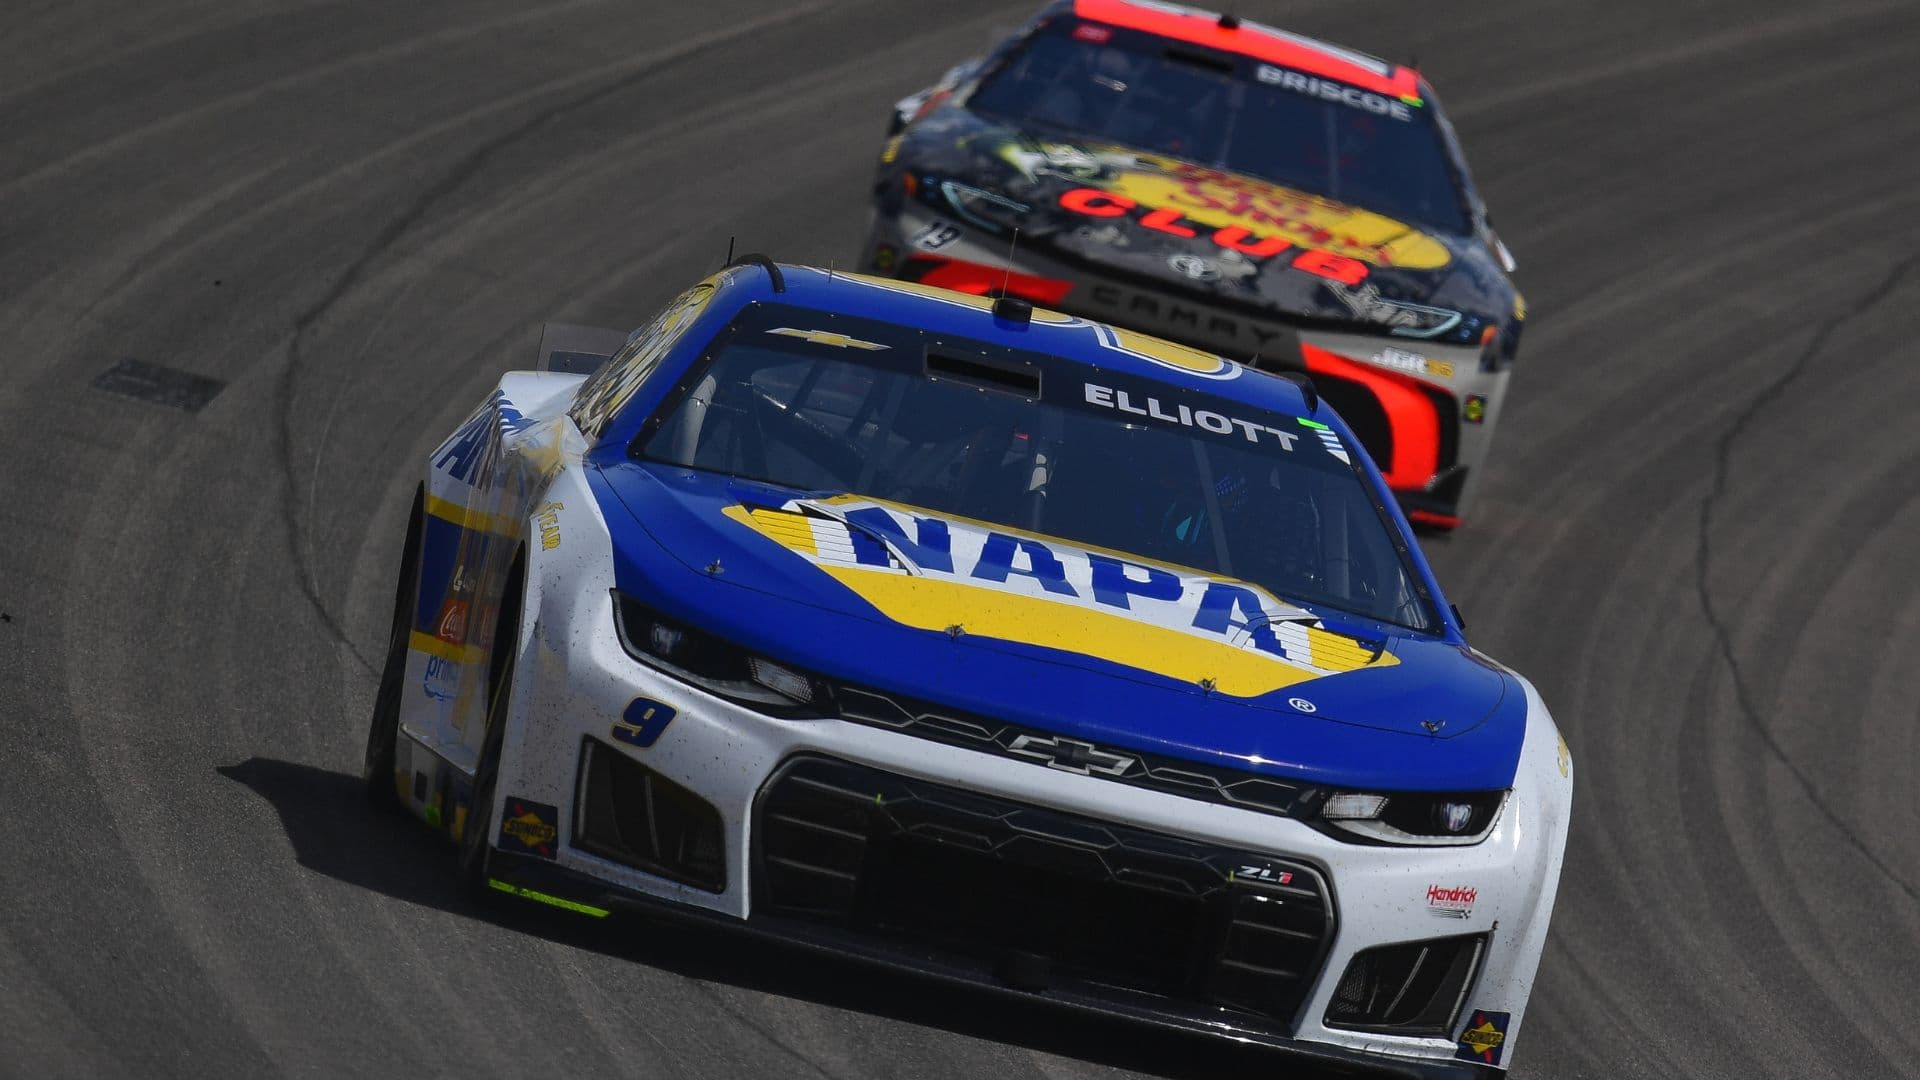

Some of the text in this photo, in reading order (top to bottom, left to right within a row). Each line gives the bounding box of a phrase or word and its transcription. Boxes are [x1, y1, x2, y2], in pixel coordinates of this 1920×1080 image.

[1257, 63, 1413, 122] BRISCOE
[1060, 188, 1369, 286] CLUB
[1092, 285, 1281, 346] CAMRY
[1084, 382, 1299, 452] ELLIOTT
[844, 504, 1294, 662] NAPA
[609, 692, 680, 751] 9
[1236, 864, 1294, 886] ZL1
[1426, 884, 1478, 906] Hendrick
